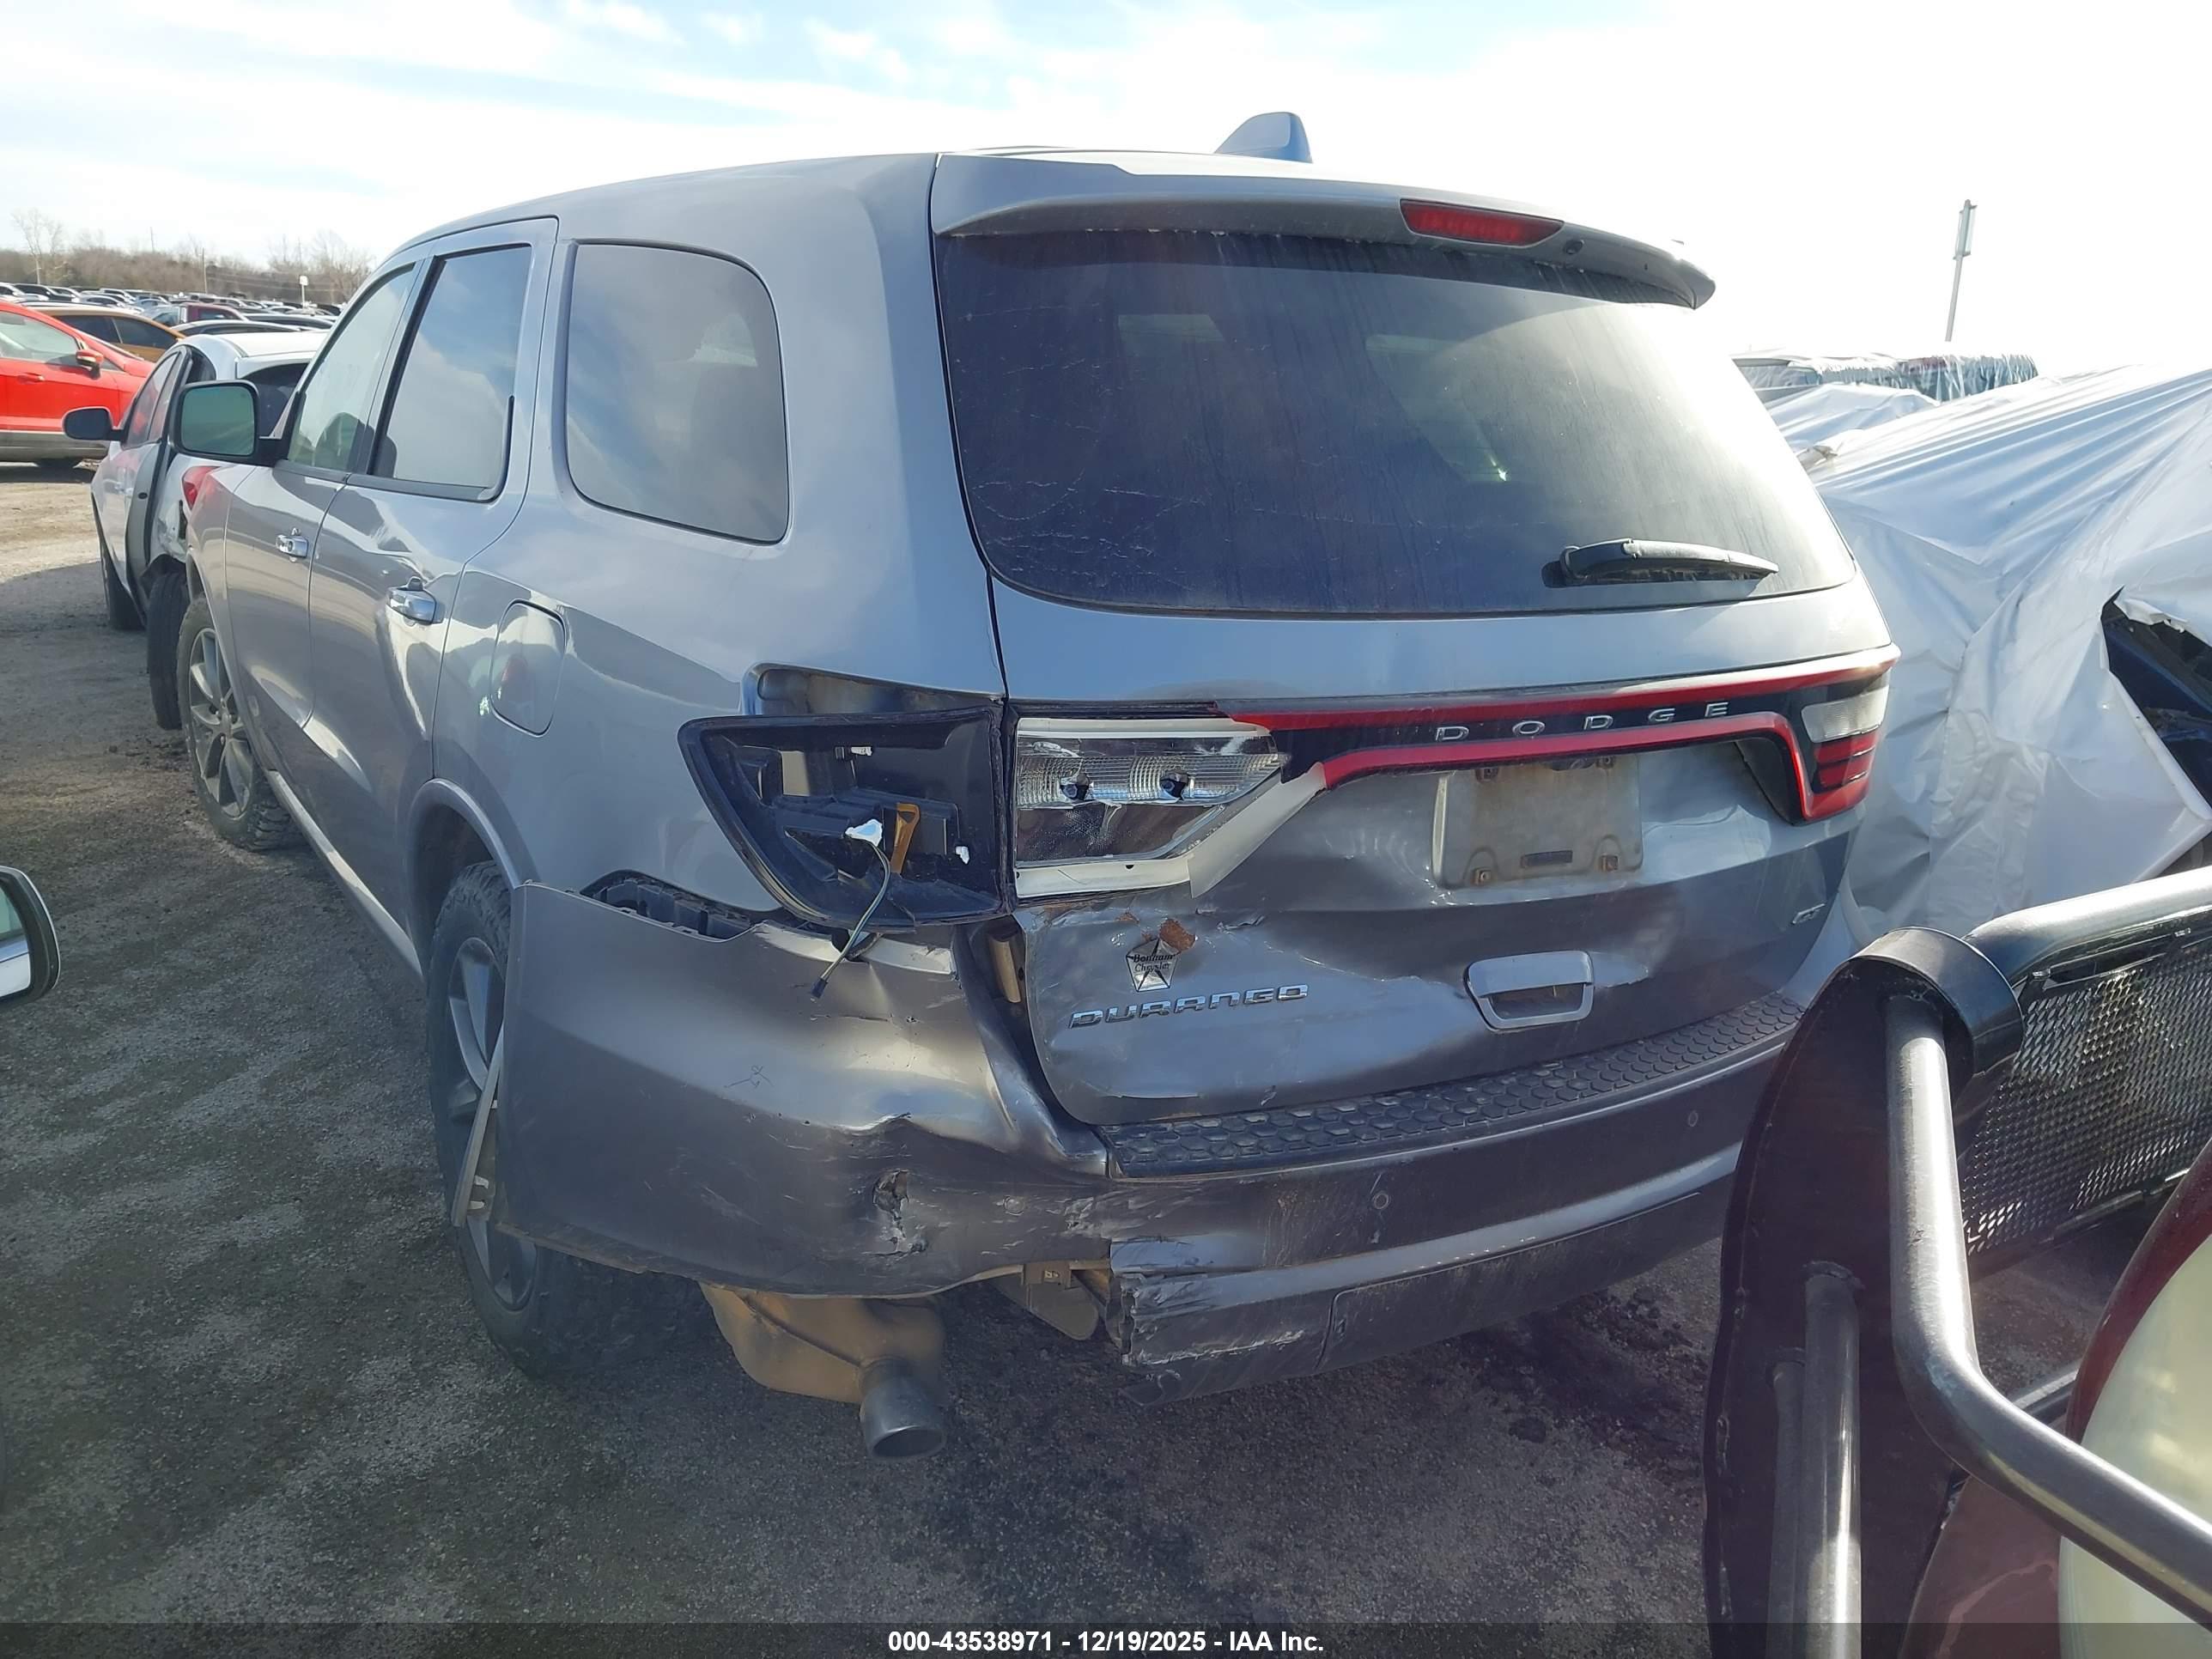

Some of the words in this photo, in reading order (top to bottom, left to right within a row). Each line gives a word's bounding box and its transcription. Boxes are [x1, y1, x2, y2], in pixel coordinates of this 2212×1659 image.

[1434, 701, 1730, 742] DODGE
[1134, 962, 1171, 972] Chrysler
[1068, 983, 1310, 1029] DURANGO
